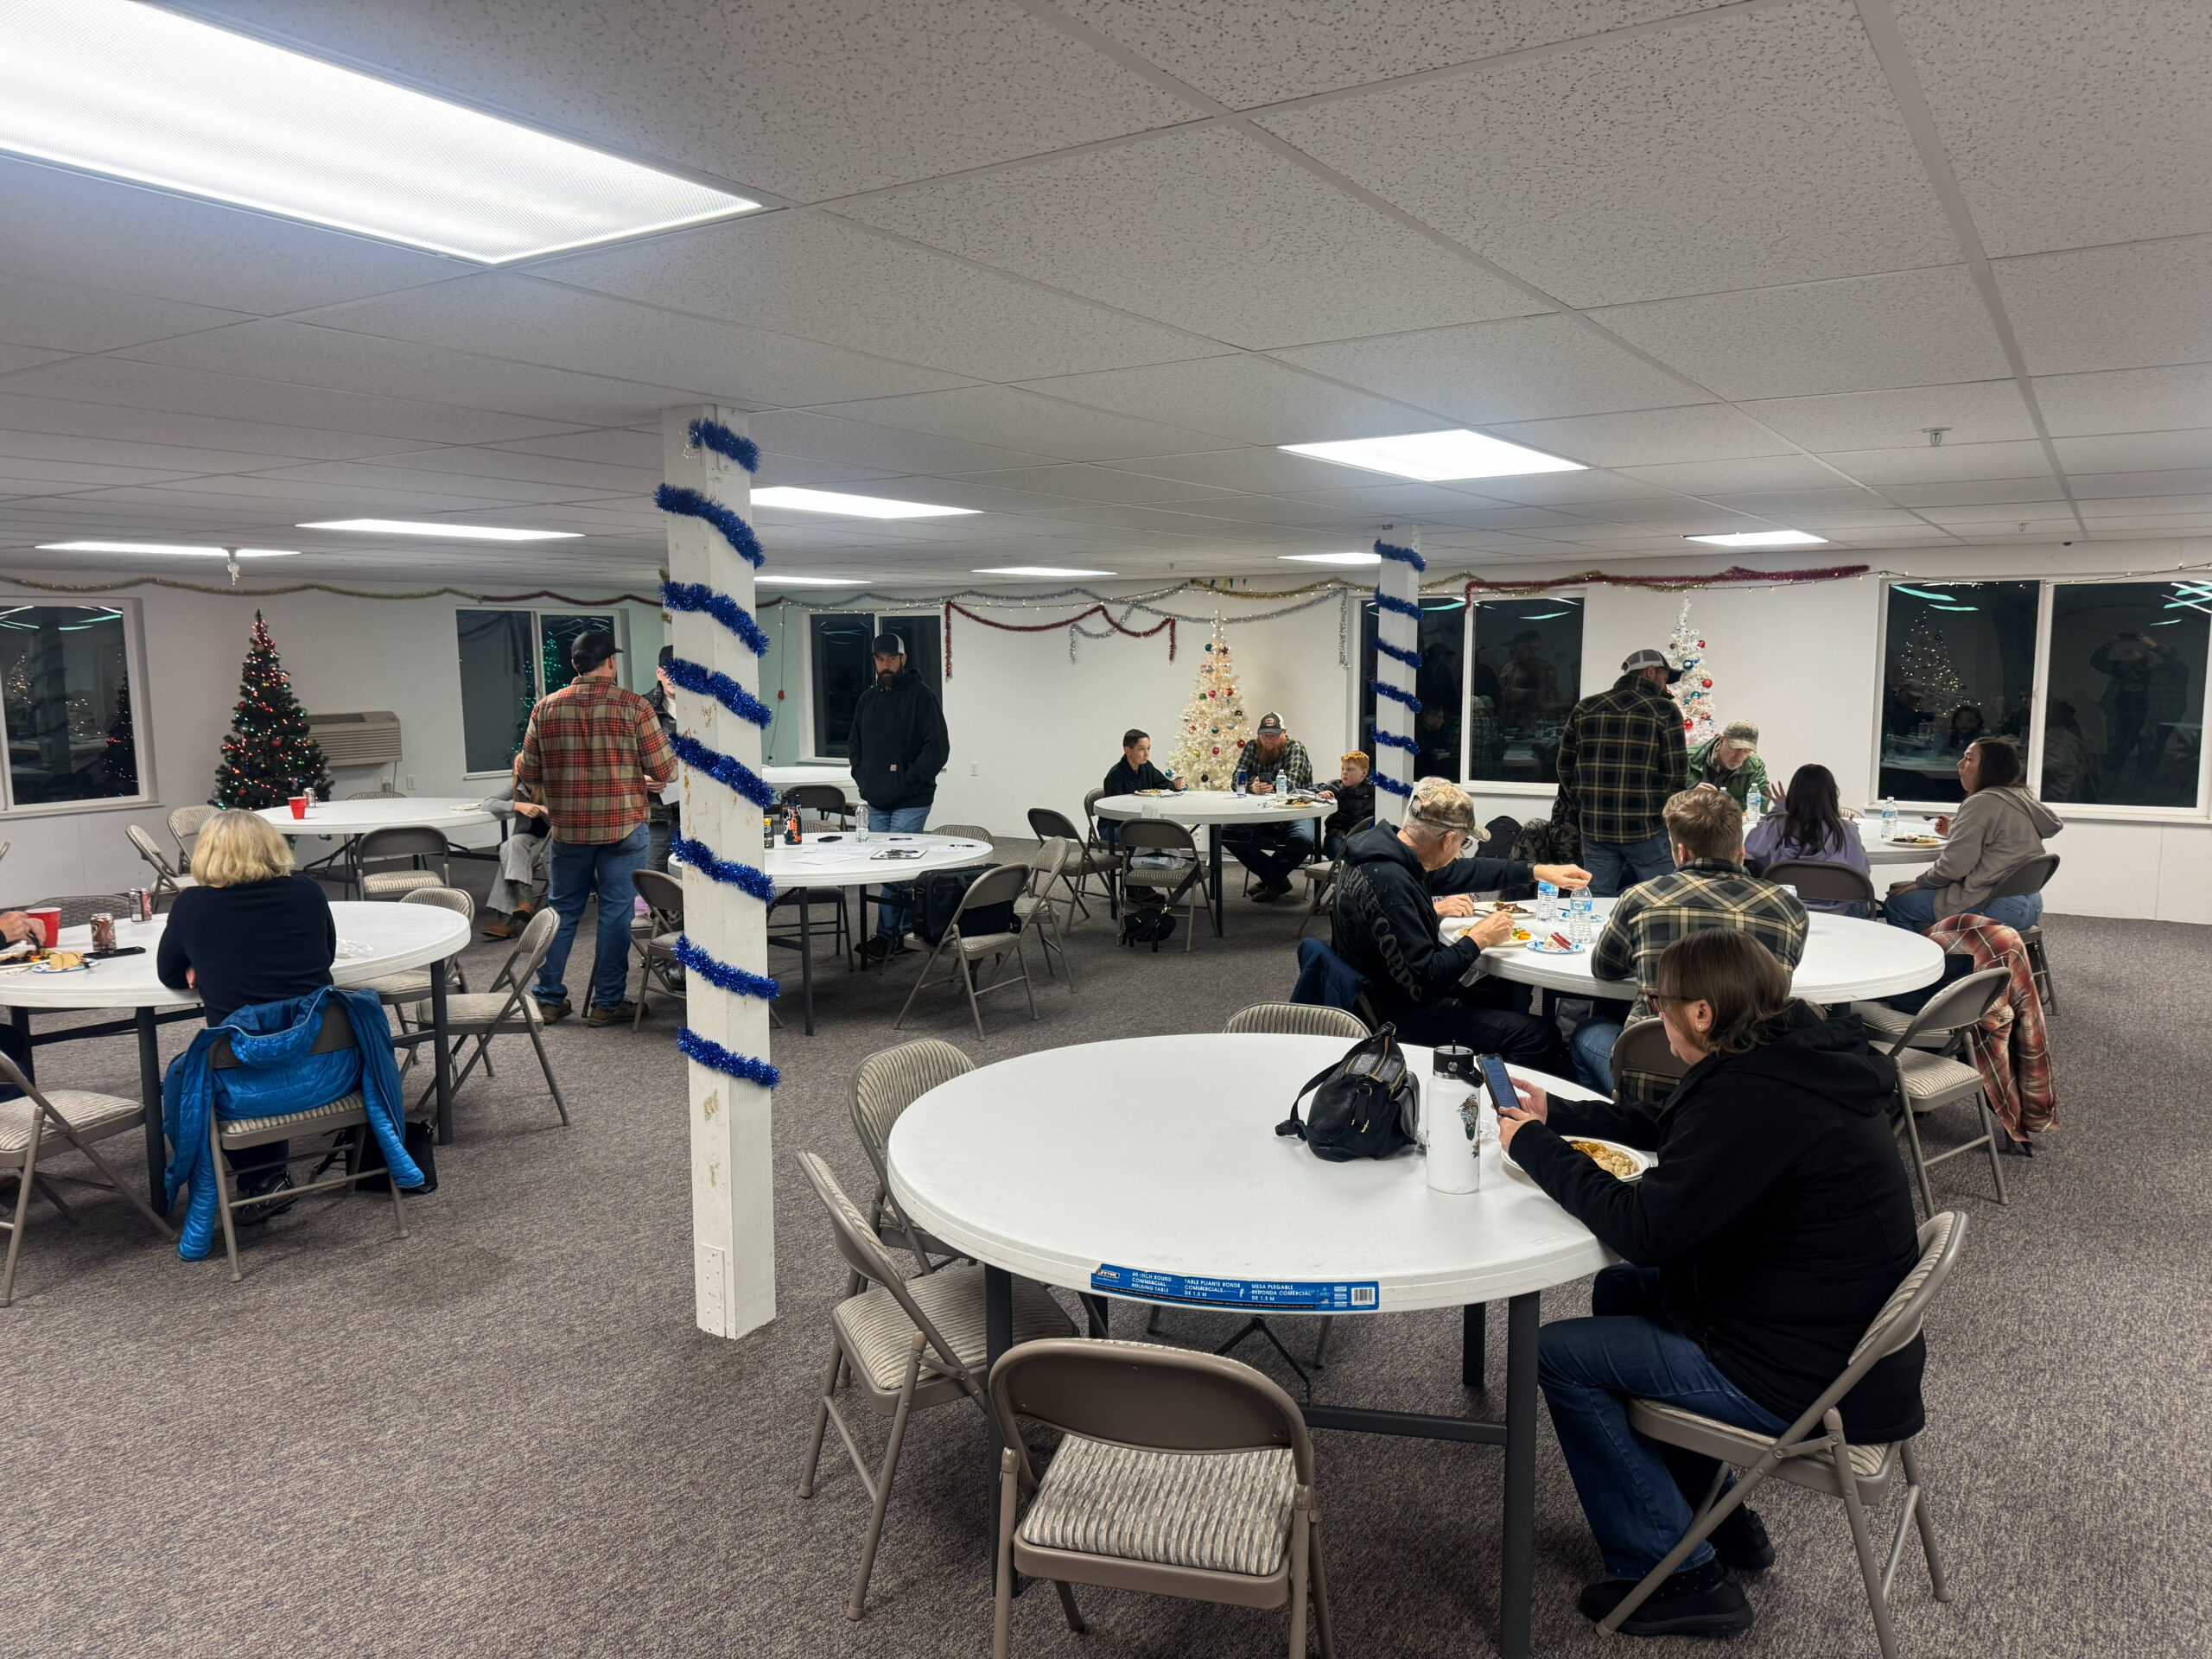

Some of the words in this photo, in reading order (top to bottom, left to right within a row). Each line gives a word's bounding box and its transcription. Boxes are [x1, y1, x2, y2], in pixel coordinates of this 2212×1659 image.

[1131, 1277, 1166, 1287] COMMERCIAL
[1131, 1282, 1154, 1291] FOLDING
[1184, 1285, 1224, 1294] COMMERCIALE
